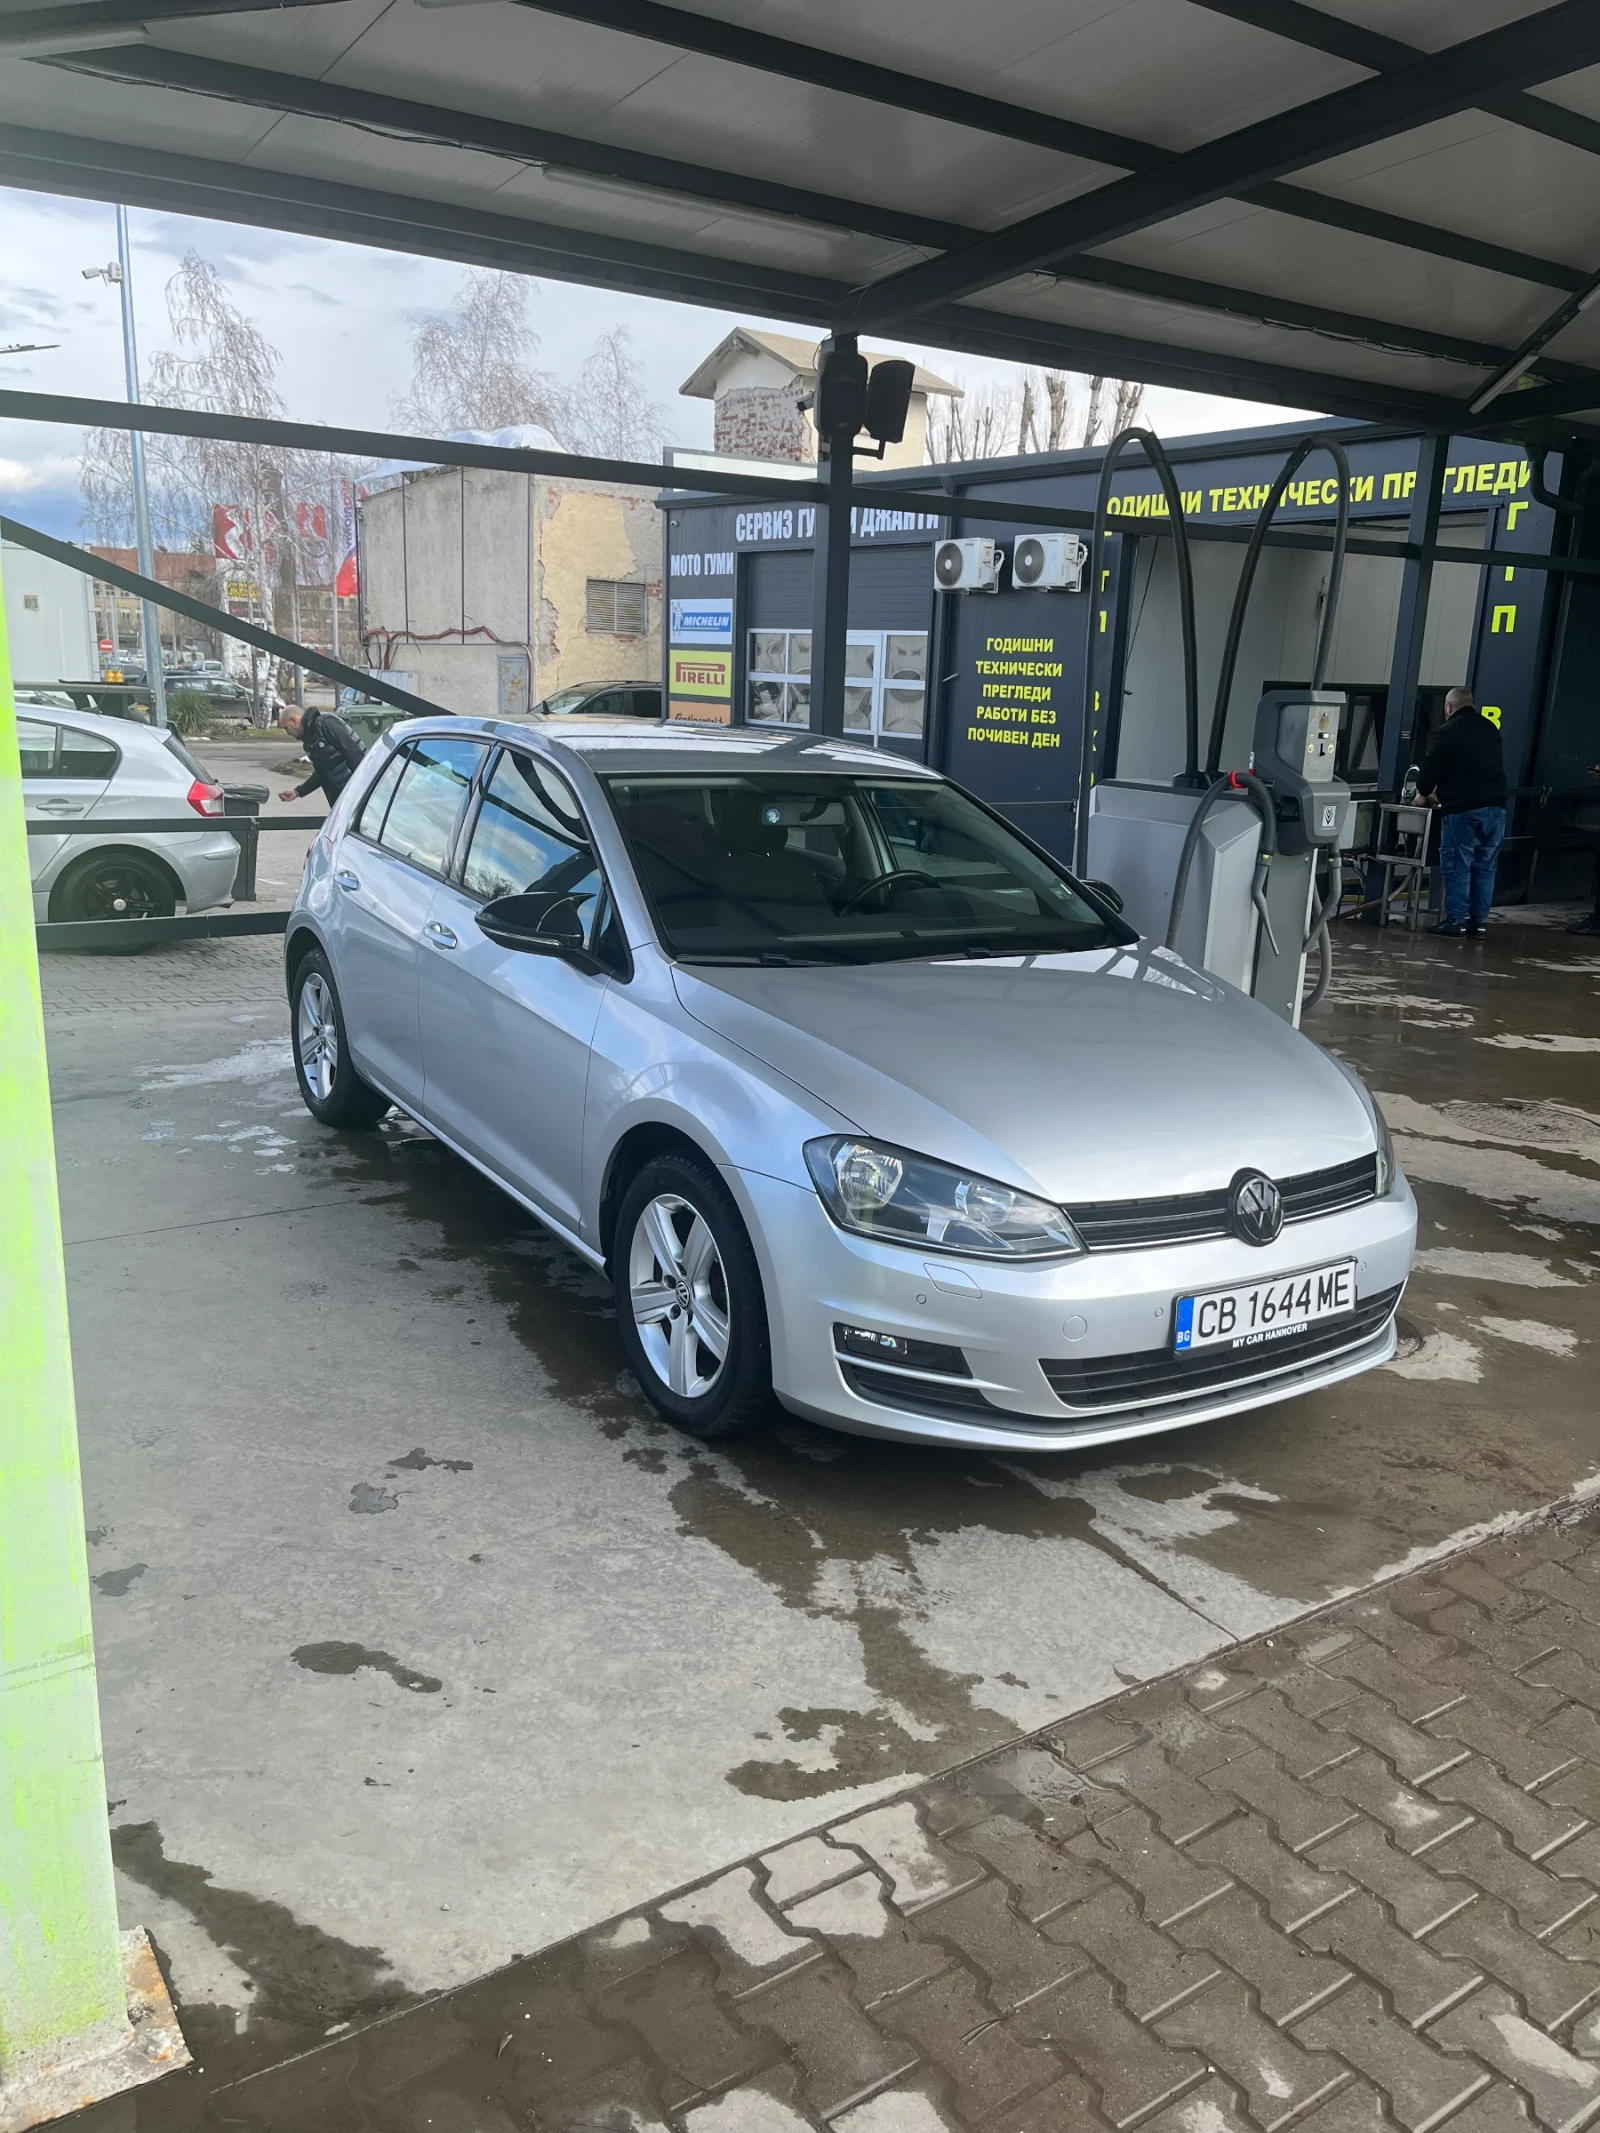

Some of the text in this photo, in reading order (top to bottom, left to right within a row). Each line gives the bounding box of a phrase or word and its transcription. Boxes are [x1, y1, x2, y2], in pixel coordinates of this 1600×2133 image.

[1107, 460, 1531, 517] ОДИШИ ТЕХНЧЕСИ ПРГЛЕДИ
[735, 509, 793, 542] СЕРВИЗ
[670, 552, 734, 577] МОТО ГУМИ
[683, 616, 730, 627] MICHELIN
[986, 638, 1054, 654] ГОДИШНИ
[676, 661, 726, 686] PIRELLI
[975, 660, 1063, 677] ТЕХНИЧЕСКИ
[982, 684, 1051, 703] ПРЕГЛЕДИ
[976, 706, 1057, 724] РАБОТИ БЕЗ
[967, 727, 1060, 748] ПОЧИВЕН ДЕН
[1177, 1330, 1190, 1344] BG
[1249, 1278, 1311, 1327] 1644
[1232, 1322, 1308, 1348] MY CAR HANNOVER
